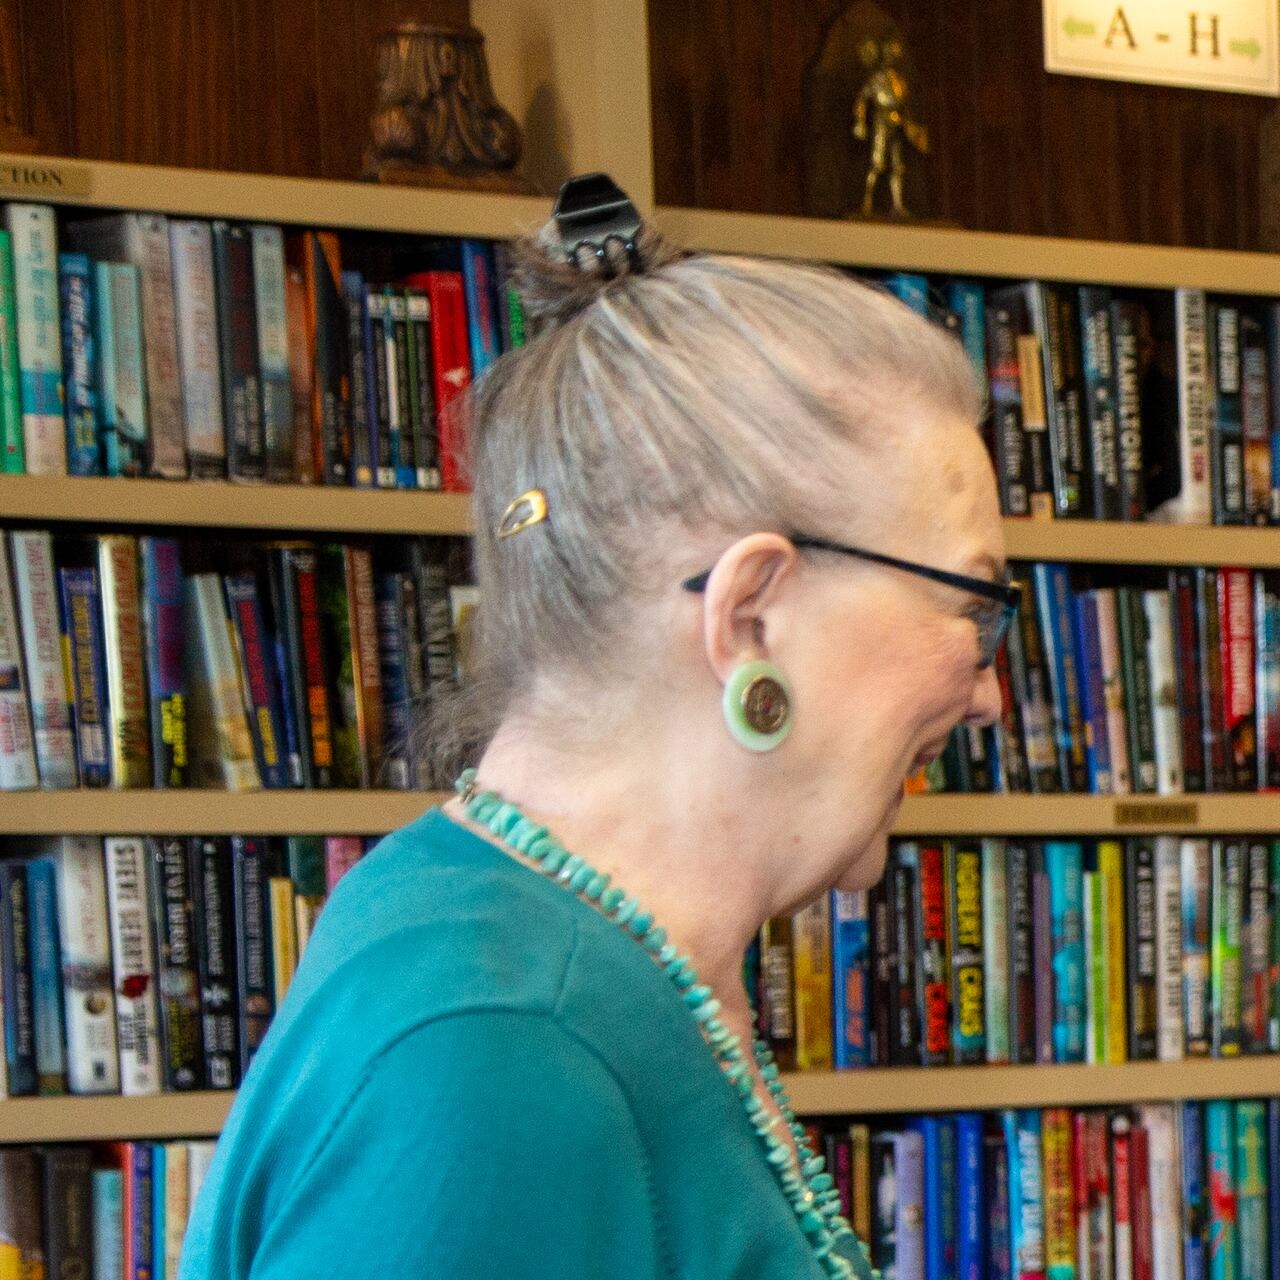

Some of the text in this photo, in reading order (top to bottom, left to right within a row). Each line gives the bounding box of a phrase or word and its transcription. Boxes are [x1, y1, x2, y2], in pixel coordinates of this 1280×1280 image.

[1103, 6, 1138, 50] A
[1187, 12, 1221, 59] H
[0, 164, 63, 187] TION
[1116, 334, 1143, 471] HAMILTON
[956, 851, 984, 1037] ROBERT CRAIS
